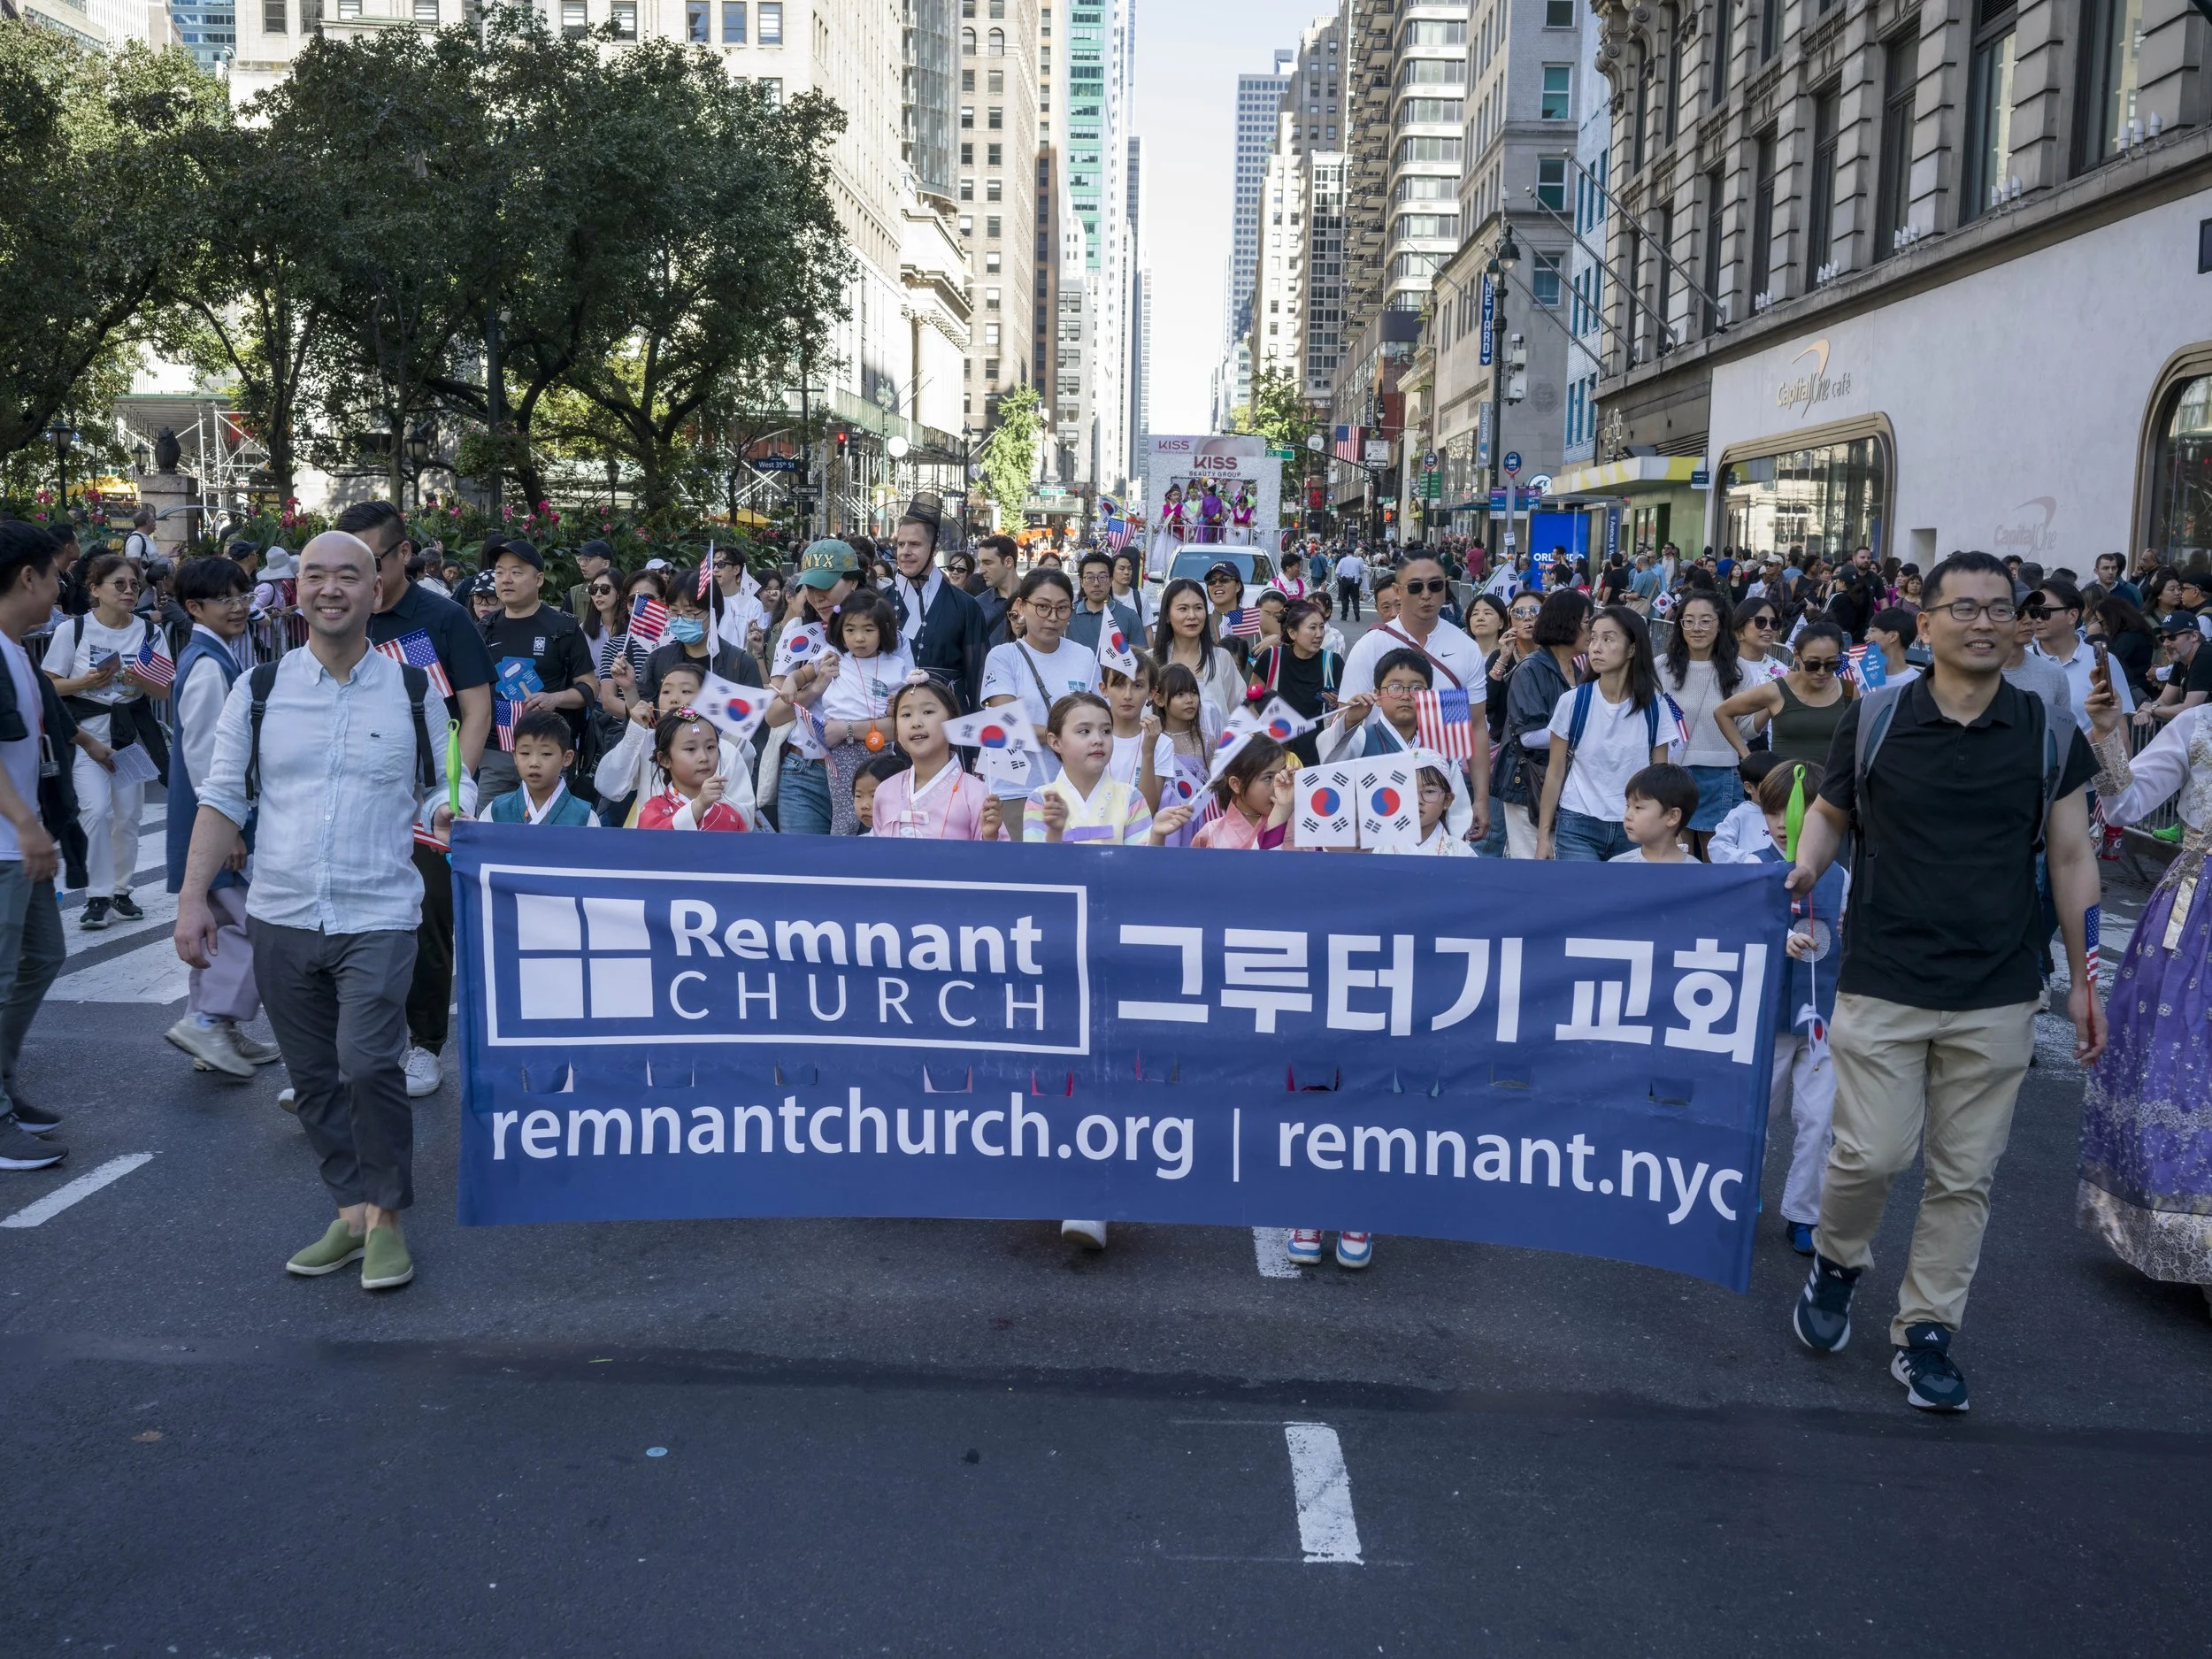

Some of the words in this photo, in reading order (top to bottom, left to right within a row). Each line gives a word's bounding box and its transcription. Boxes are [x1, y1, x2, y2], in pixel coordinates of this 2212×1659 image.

[1482, 309, 1491, 354] YARD
[1777, 373, 1813, 411] Capital
[1832, 373, 1851, 397] café
[1480, 403, 1489, 443] BankUnited
[1158, 440, 1190, 450] KISS
[1194, 456, 1238, 470] KISS
[1993, 524, 2036, 550] Capital
[669, 899, 1043, 975] Remnant
[669, 971, 1044, 1031] CHURCH
[1118, 924, 1523, 1043] 그루터기
[1555, 938, 1767, 1065] 교회
[492, 1087, 1194, 1181] remnantchurch.org
[1279, 1119, 1744, 1225] remnant.nyc
